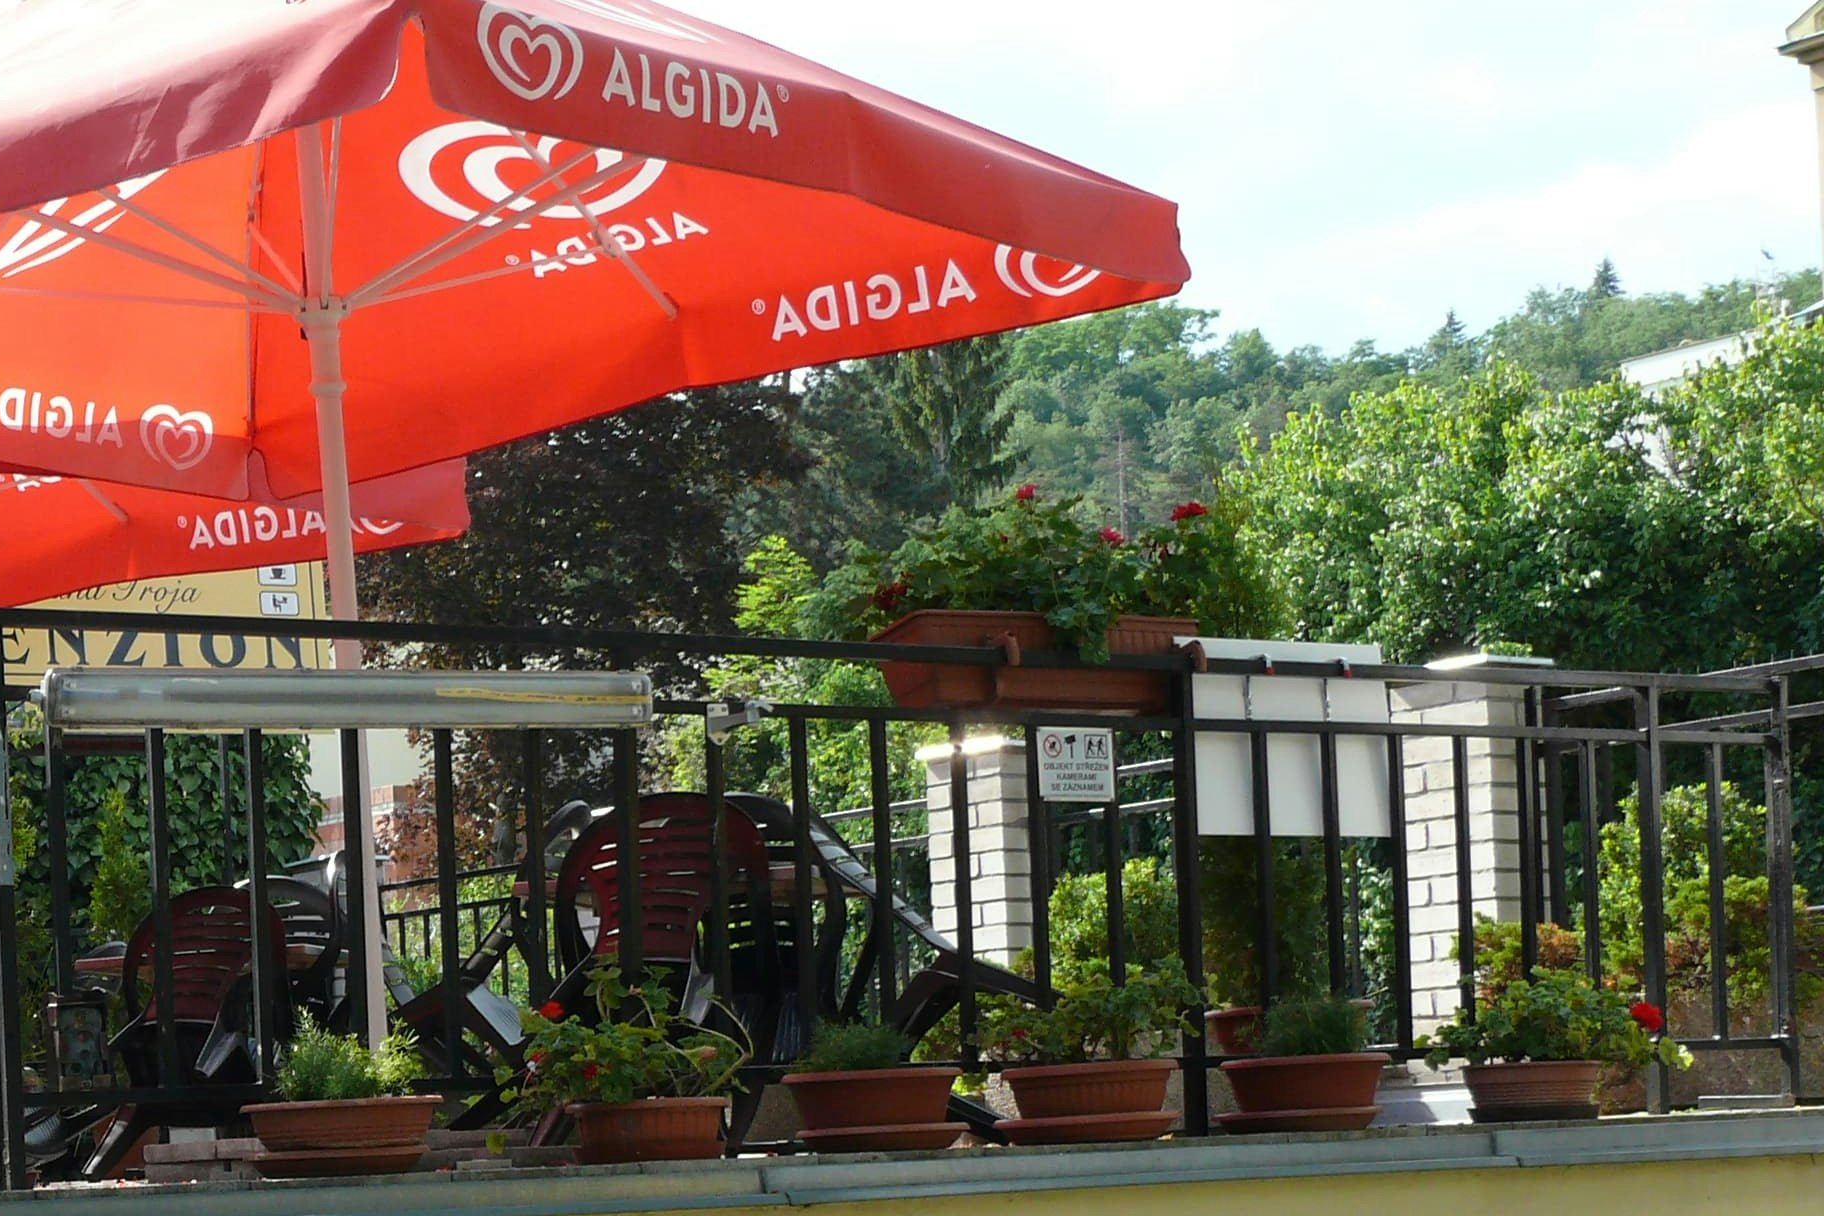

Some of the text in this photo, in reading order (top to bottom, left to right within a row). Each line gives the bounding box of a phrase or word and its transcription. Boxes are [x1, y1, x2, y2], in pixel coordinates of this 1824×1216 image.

[601, 47, 778, 138] ALGIDA
[113, 580, 201, 614] Troja
[1, 625, 306, 669] ENZION
[1043, 762, 1073, 770] OBJEKT
[1051, 783, 1061, 791] SE
[1056, 773, 1097, 781] KAMERAMI
